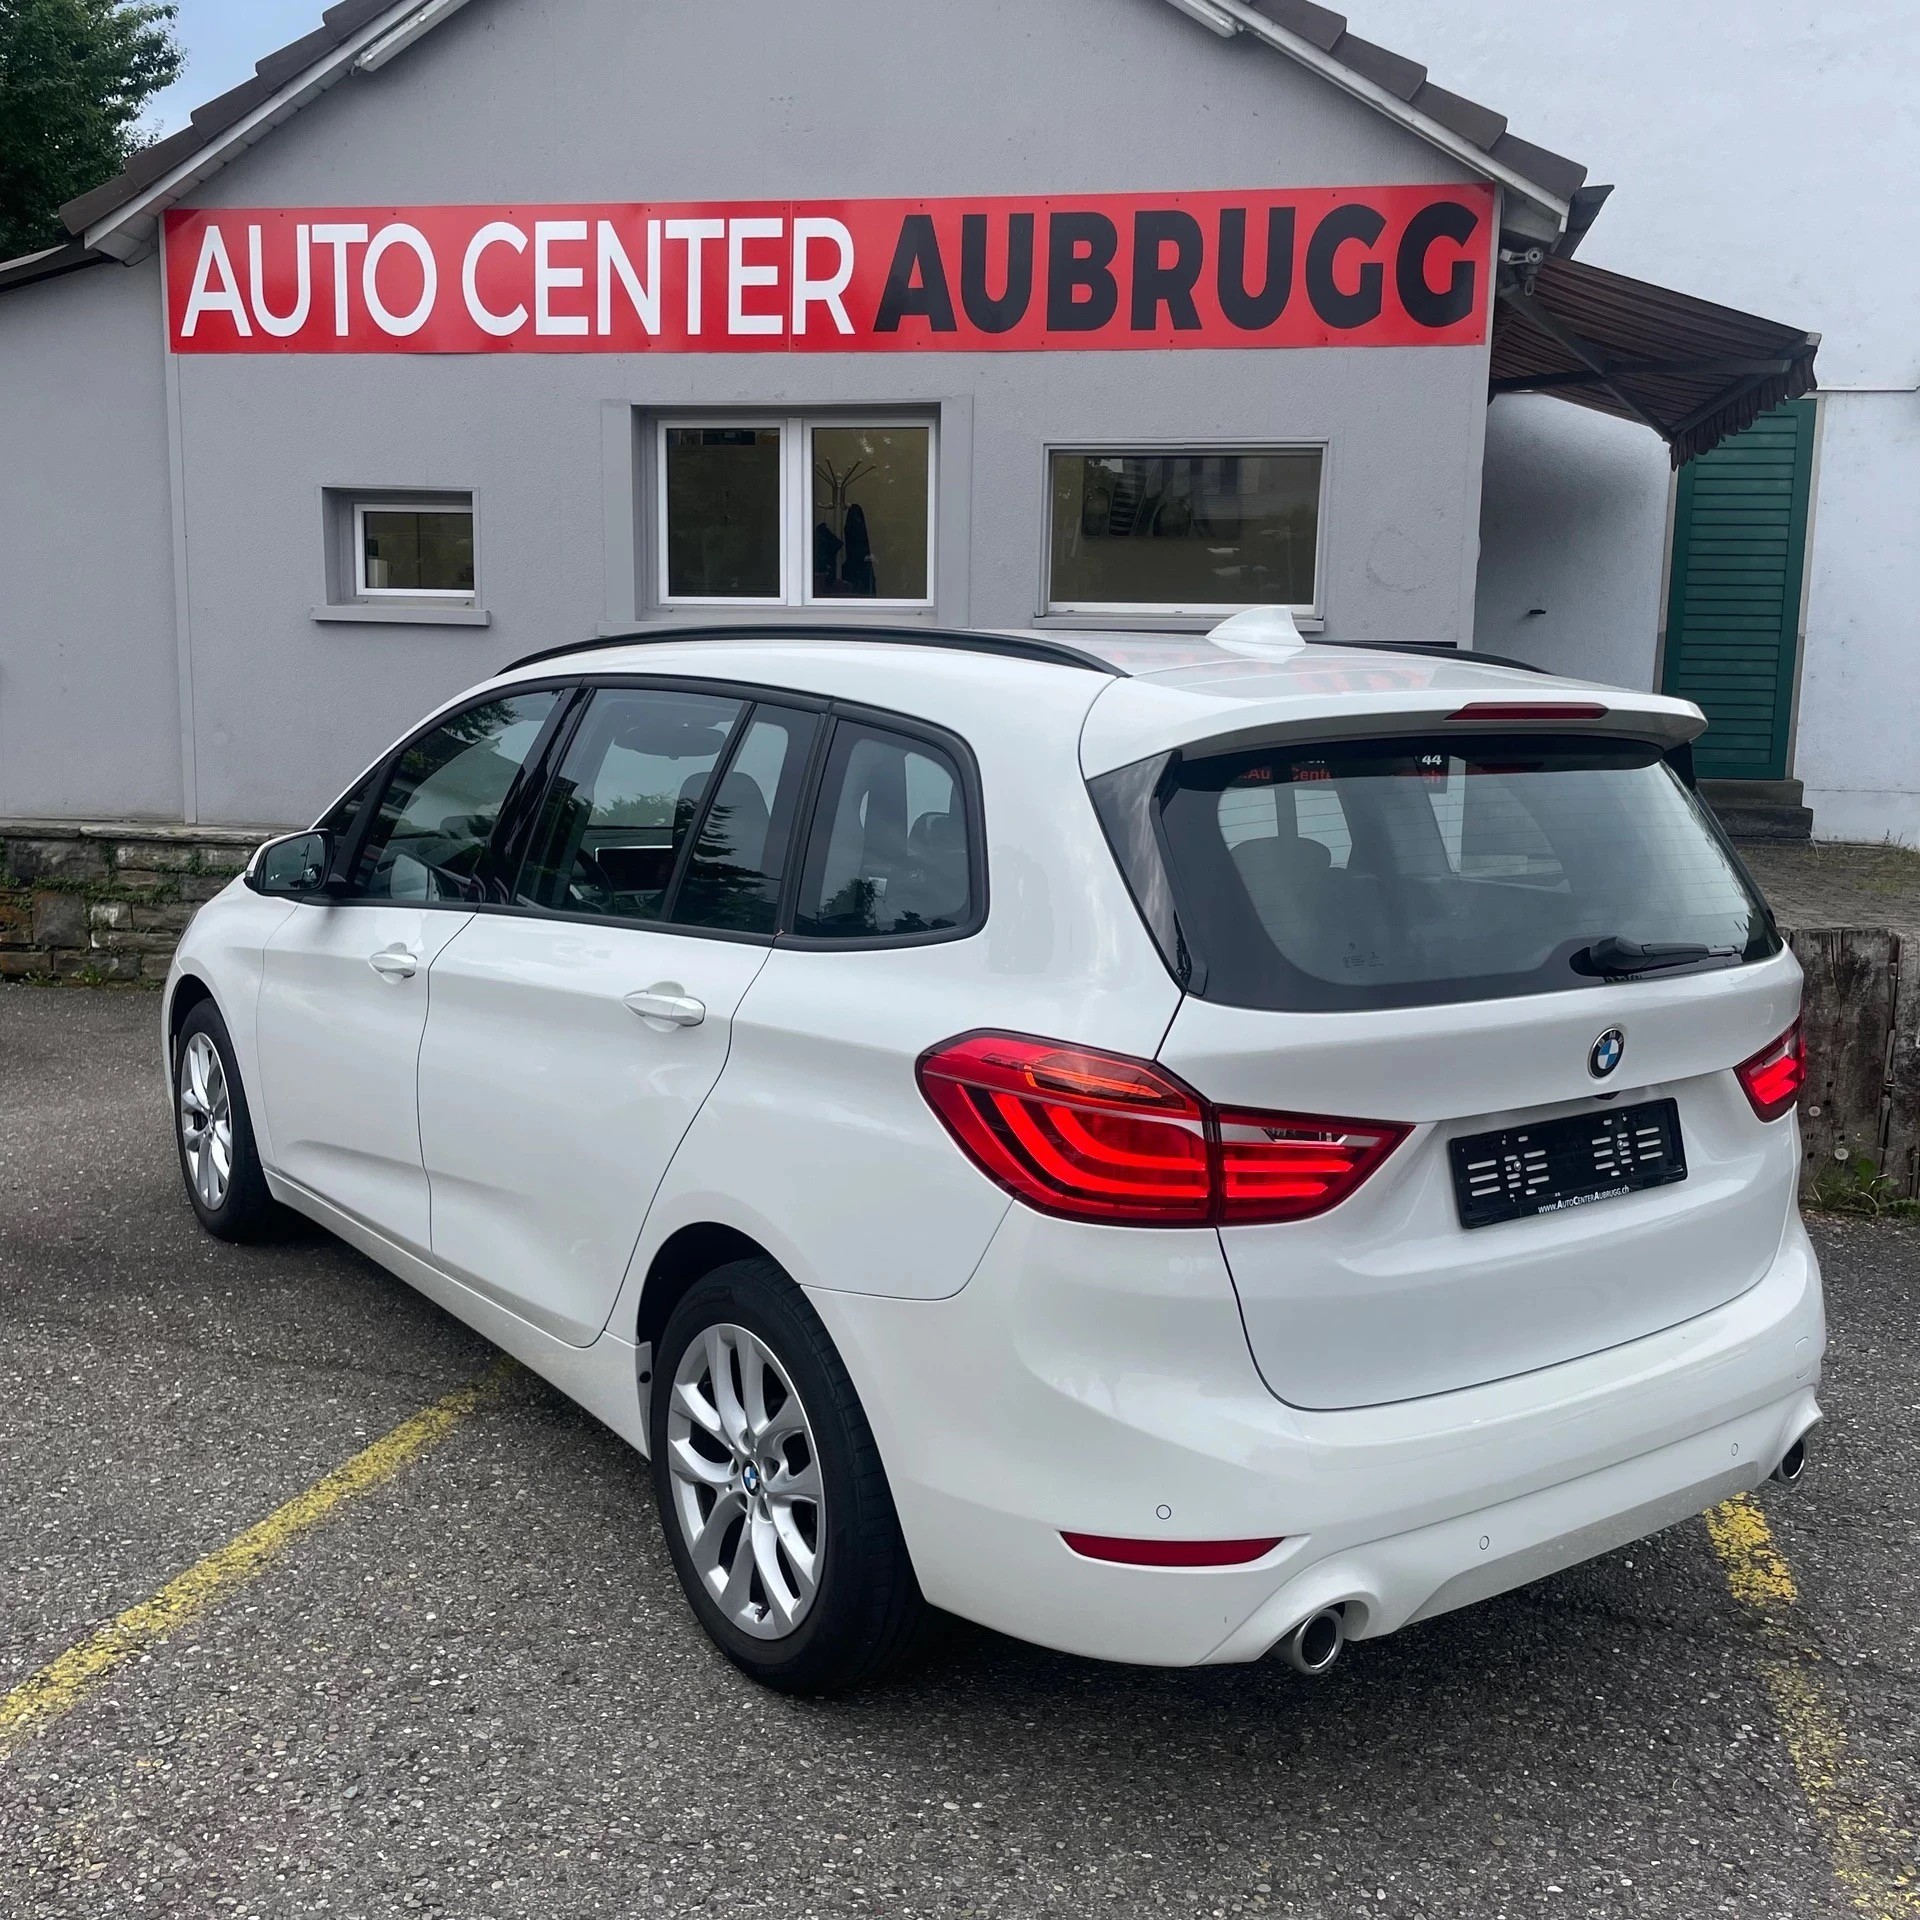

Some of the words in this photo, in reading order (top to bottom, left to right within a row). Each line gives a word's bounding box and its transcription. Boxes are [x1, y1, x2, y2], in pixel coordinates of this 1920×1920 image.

[180, 222, 437, 338] AUTO
[461, 216, 856, 337] CENTER
[873, 201, 1479, 334] AUBRUGG
[1597, 1030, 1623, 1048] BMW
